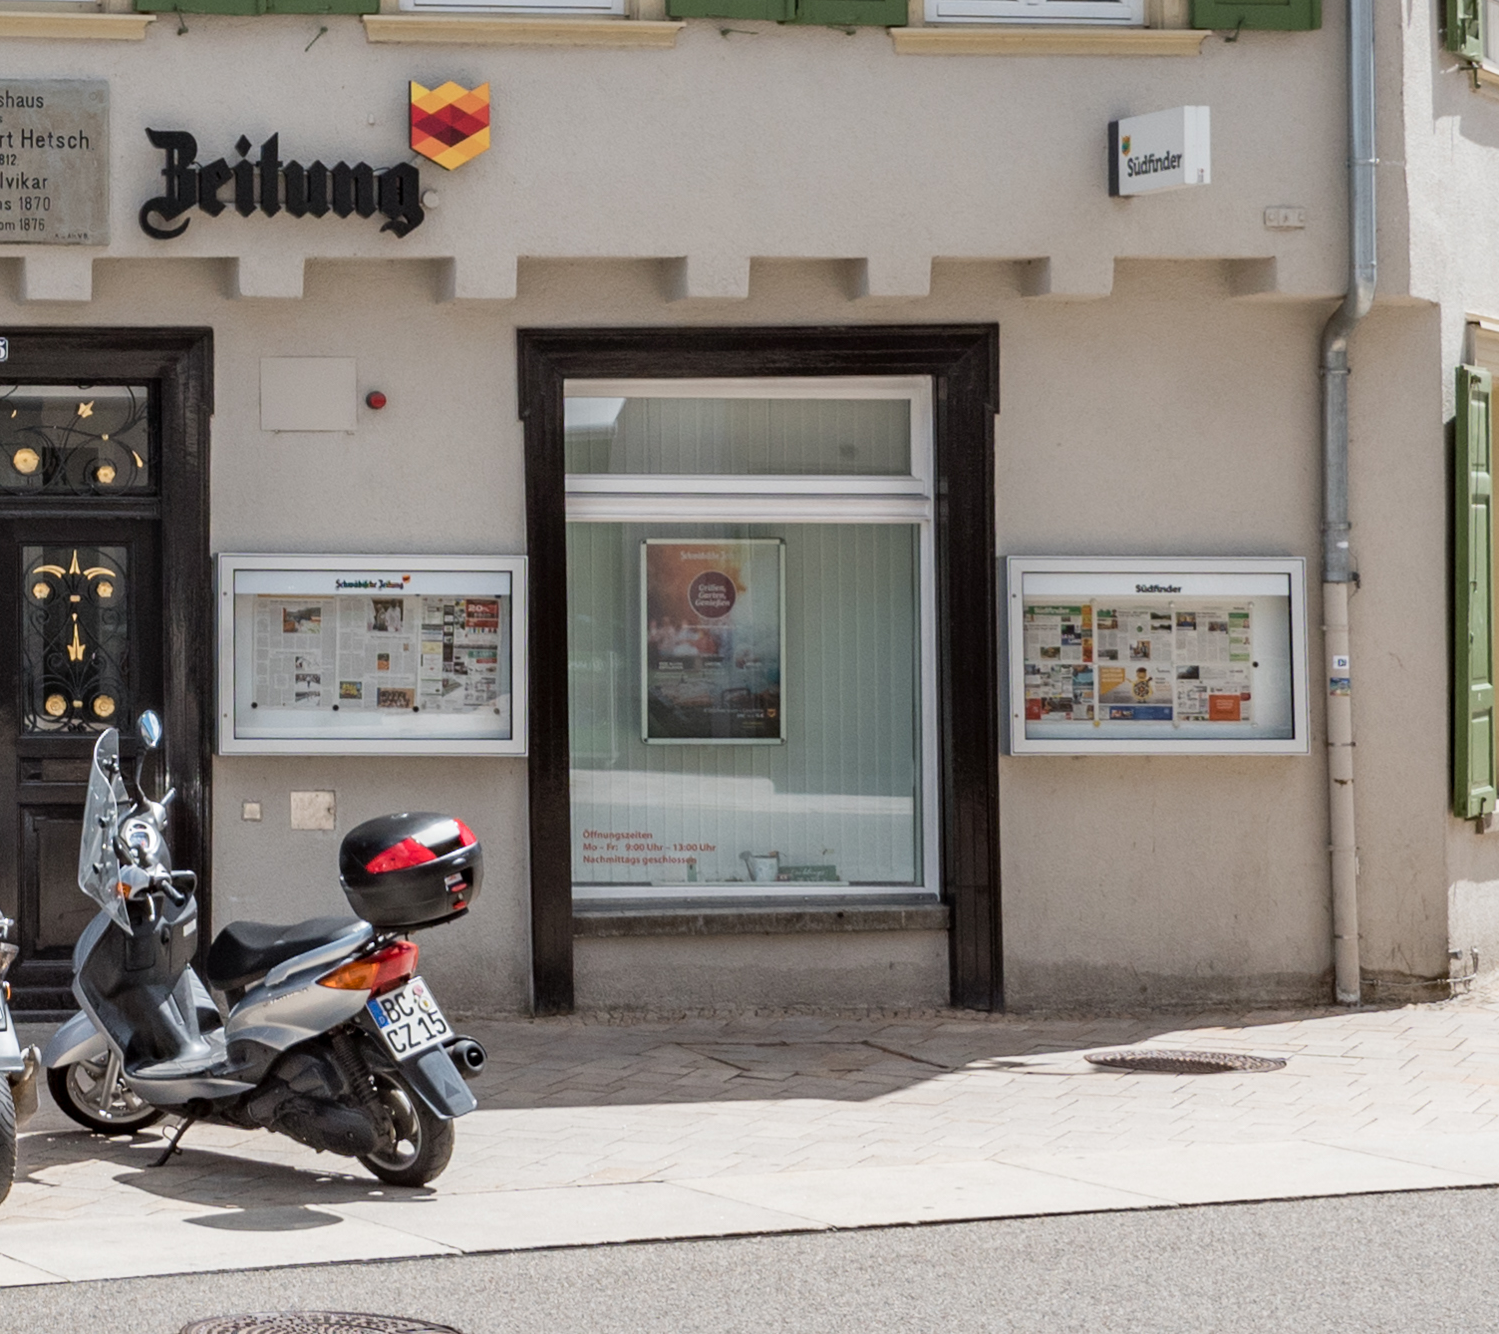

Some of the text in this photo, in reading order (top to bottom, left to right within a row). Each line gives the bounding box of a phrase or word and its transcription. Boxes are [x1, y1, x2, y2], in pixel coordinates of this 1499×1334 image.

[1127, 150, 1182, 177] Südfinder
[139, 127, 425, 239] Zeitung
[19, 196, 51, 211] 1870
[20, 218, 45, 231] 1876
[1136, 584, 1182, 593] Südfinder
[583, 829, 653, 840] Öffnungszeiten
[583, 843, 598, 852] Mo
[607, 843, 618, 852] Fr:
[625, 843, 645, 852] 9:00
[647, 843, 663, 852] Uhr
[673, 843, 697, 852] 13:00
[699, 843, 716, 852] Uhr
[583, 855, 697, 865] Nachmittags geschlossen
[381, 992, 414, 1024] BC
